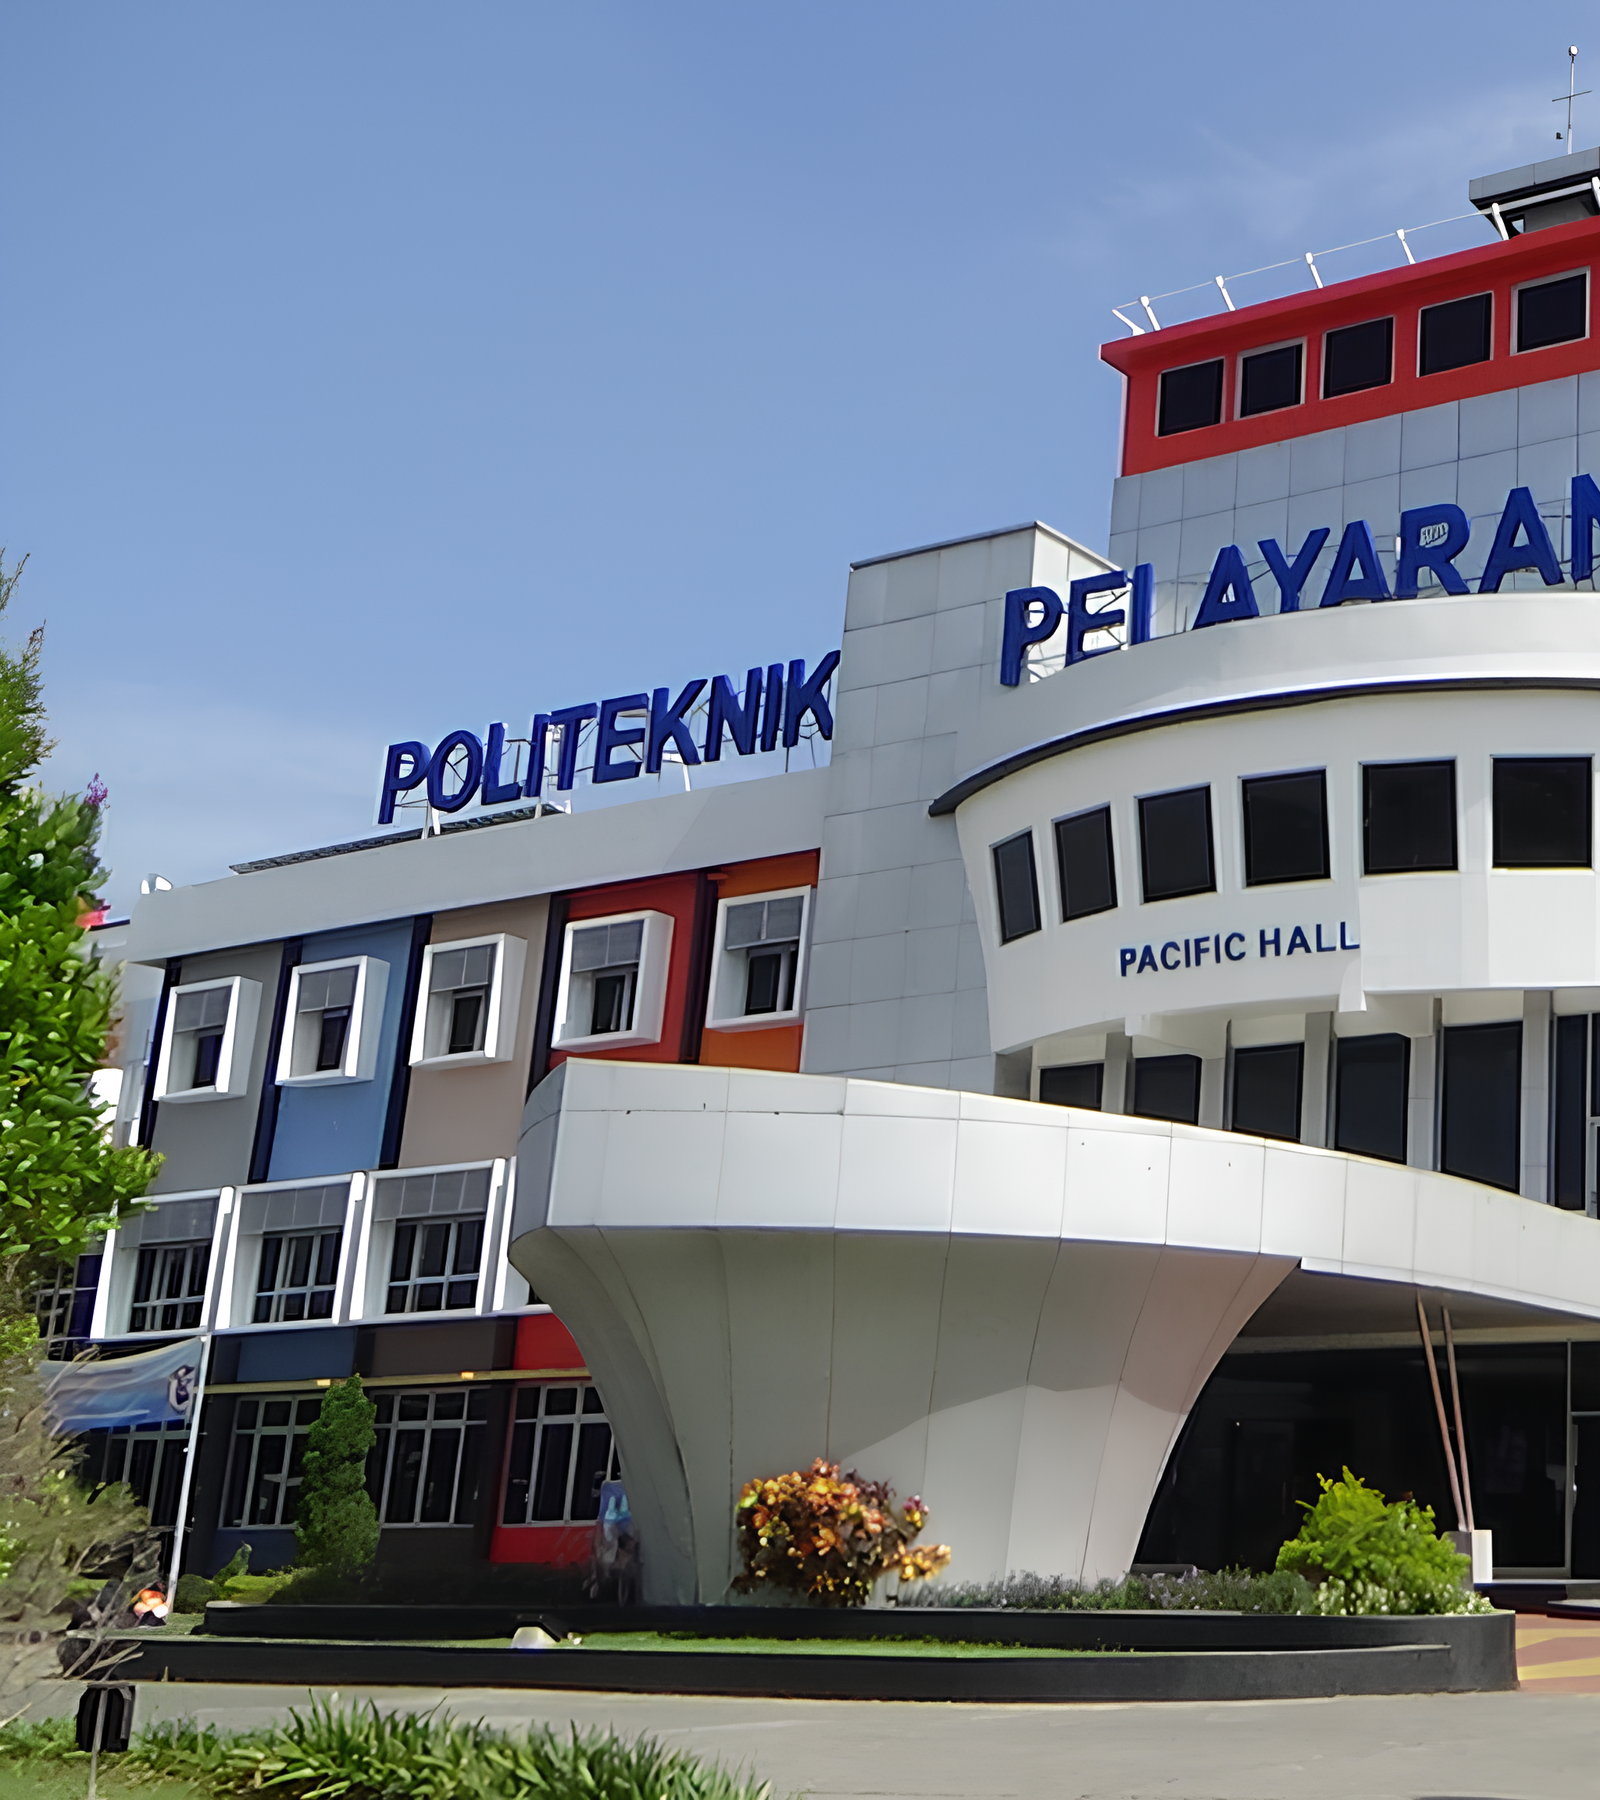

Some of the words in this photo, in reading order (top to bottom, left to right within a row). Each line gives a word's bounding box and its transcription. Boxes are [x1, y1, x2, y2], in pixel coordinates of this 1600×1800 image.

[378, 650, 840, 824] POLITEKNIK
[1120, 932, 1246, 977] PACIFIC
[1259, 921, 1360, 957] HALL
